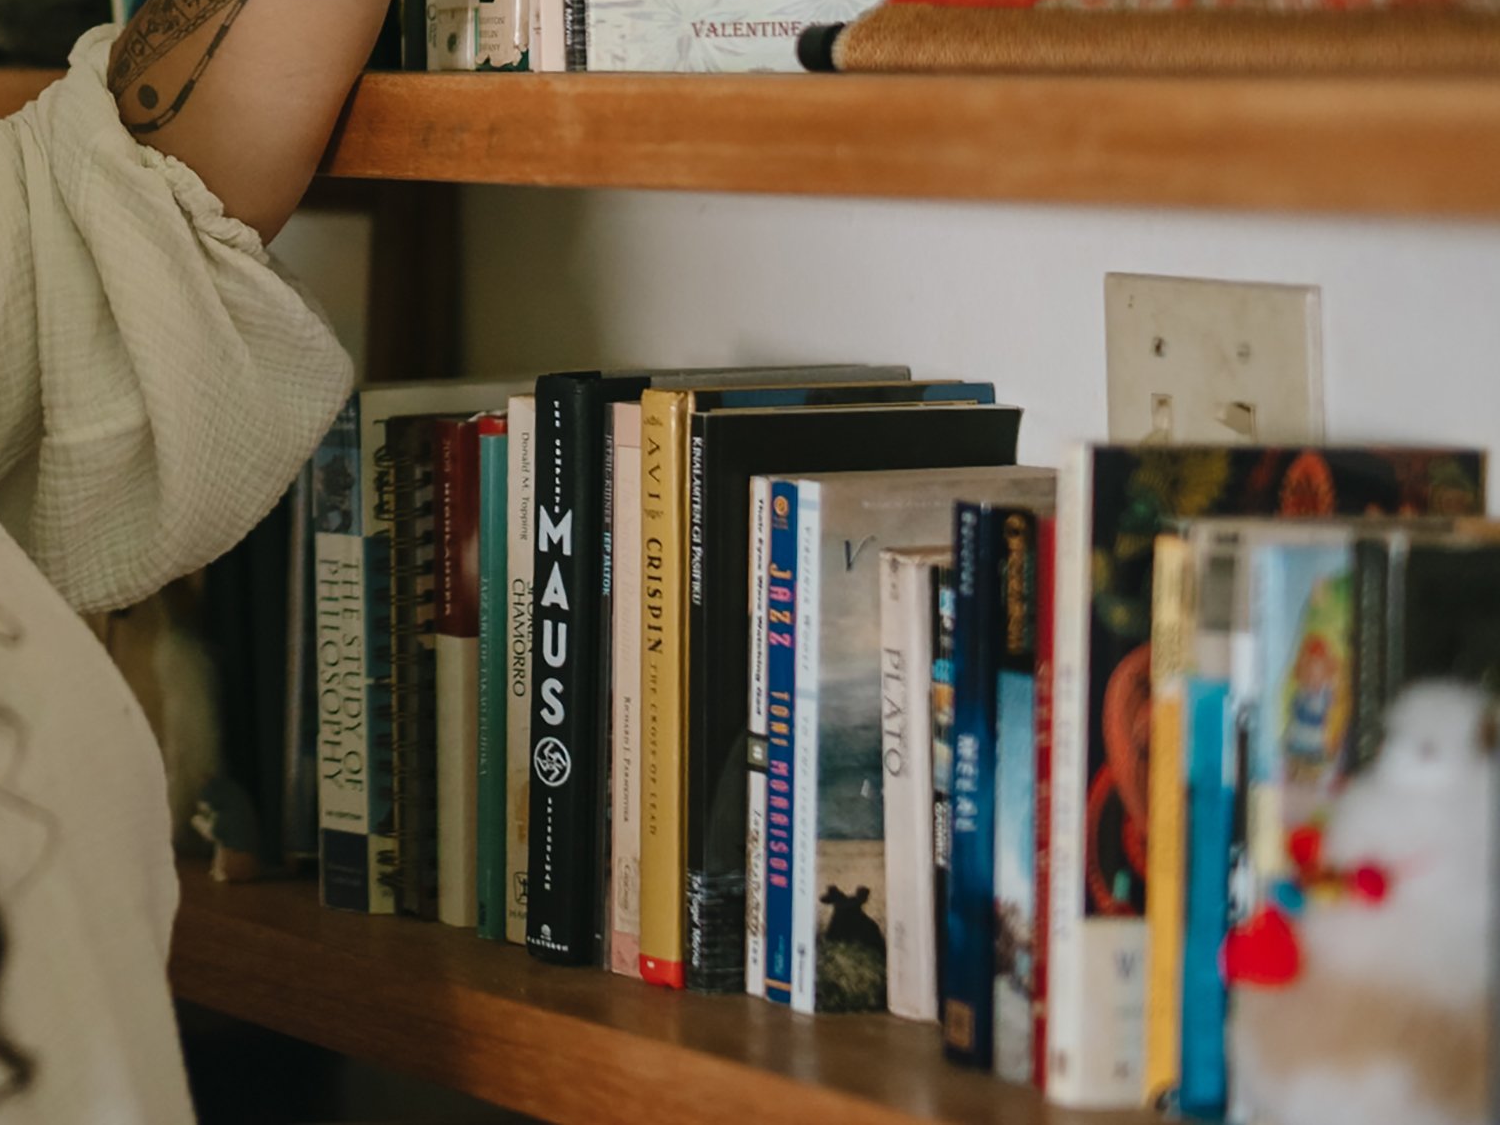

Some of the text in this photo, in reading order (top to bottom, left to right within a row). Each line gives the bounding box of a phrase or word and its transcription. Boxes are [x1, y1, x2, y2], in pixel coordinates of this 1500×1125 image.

[691, 21, 802, 38] VALENTINE
[519, 431, 531, 541] Donald M. Topping
[554, 438, 562, 514] COMPLETE
[647, 437, 661, 501] AVI
[341, 557, 361, 622] THE
[443, 481, 452, 617] HIGHLANDER
[646, 537, 663, 654] CRISPIN
[512, 578, 526, 697] CHAMORRO
[536, 504, 574, 727] MAUS
[755, 616, 765, 682] Watching
[319, 558, 344, 790] PHILOSOPHY
[341, 634, 362, 739] STUDY
[768, 563, 792, 888] JAZZ TONI MORRISON
[882, 647, 901, 778] PLATO
[343, 750, 364, 793] OF
